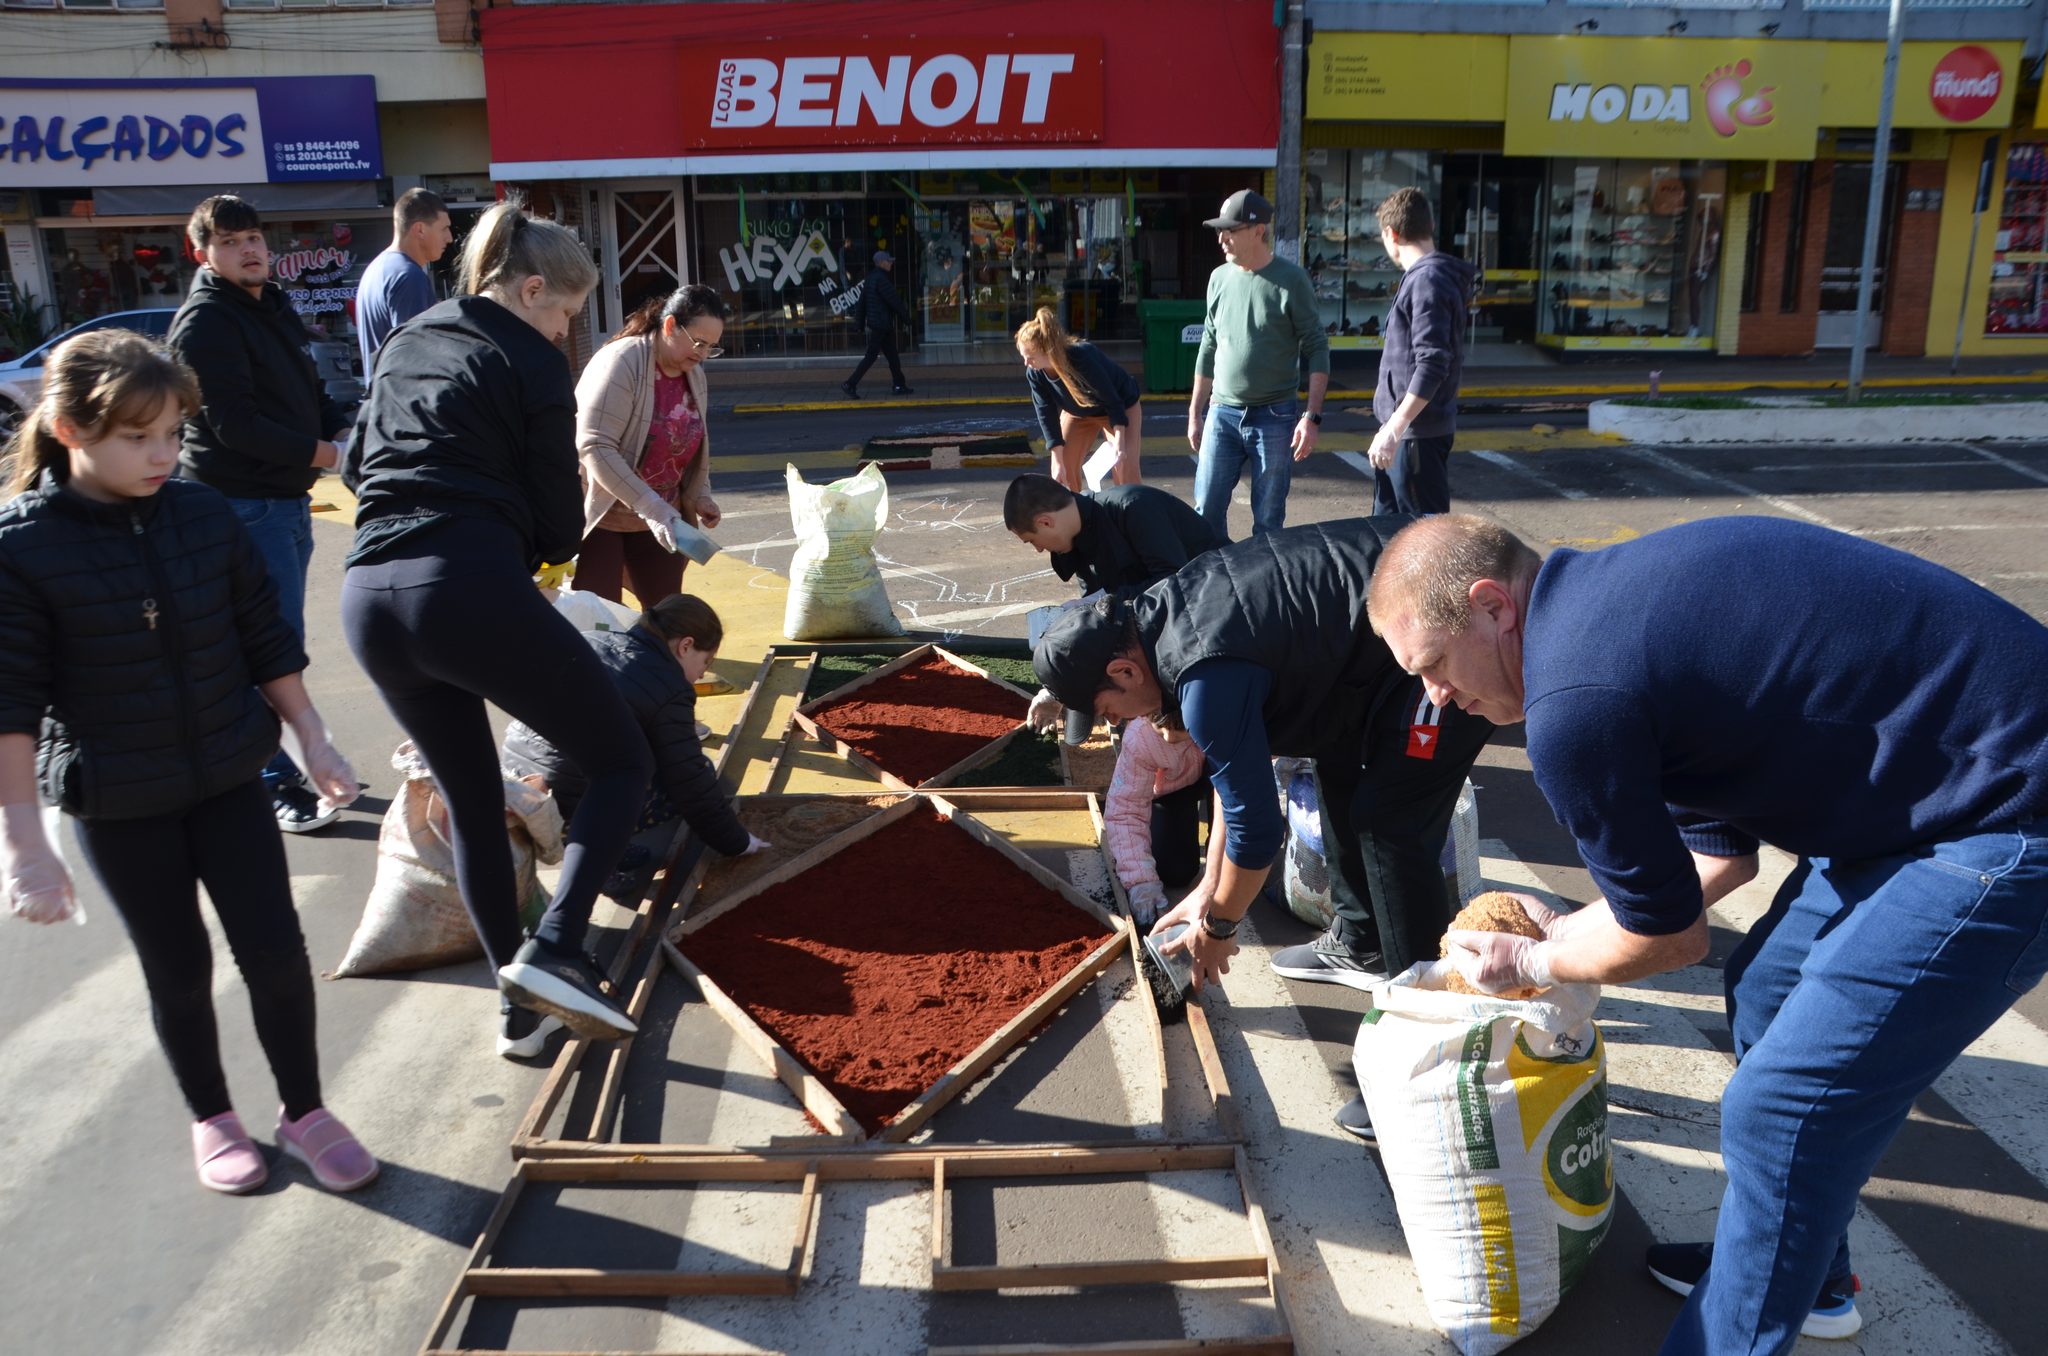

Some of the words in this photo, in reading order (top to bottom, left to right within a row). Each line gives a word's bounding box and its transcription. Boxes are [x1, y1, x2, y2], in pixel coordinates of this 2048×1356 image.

[711, 54, 1075, 128] BENOIT
[715, 62, 736, 123] LOJAS
[1933, 71, 2000, 97] mundi
[1549, 83, 1690, 124] MODA
[0, 114, 247, 170] ALÇADOS
[296, 142, 304, 151] 9
[305, 141, 360, 151] 8464-4096
[297, 151, 351, 161] 2010-6111
[286, 160, 370, 171] couroesporte.fw
[277, 247, 344, 281] amor
[719, 230, 838, 292] HEXA
[818, 276, 838, 296] NA
[829, 279, 866, 316] BENOIT
